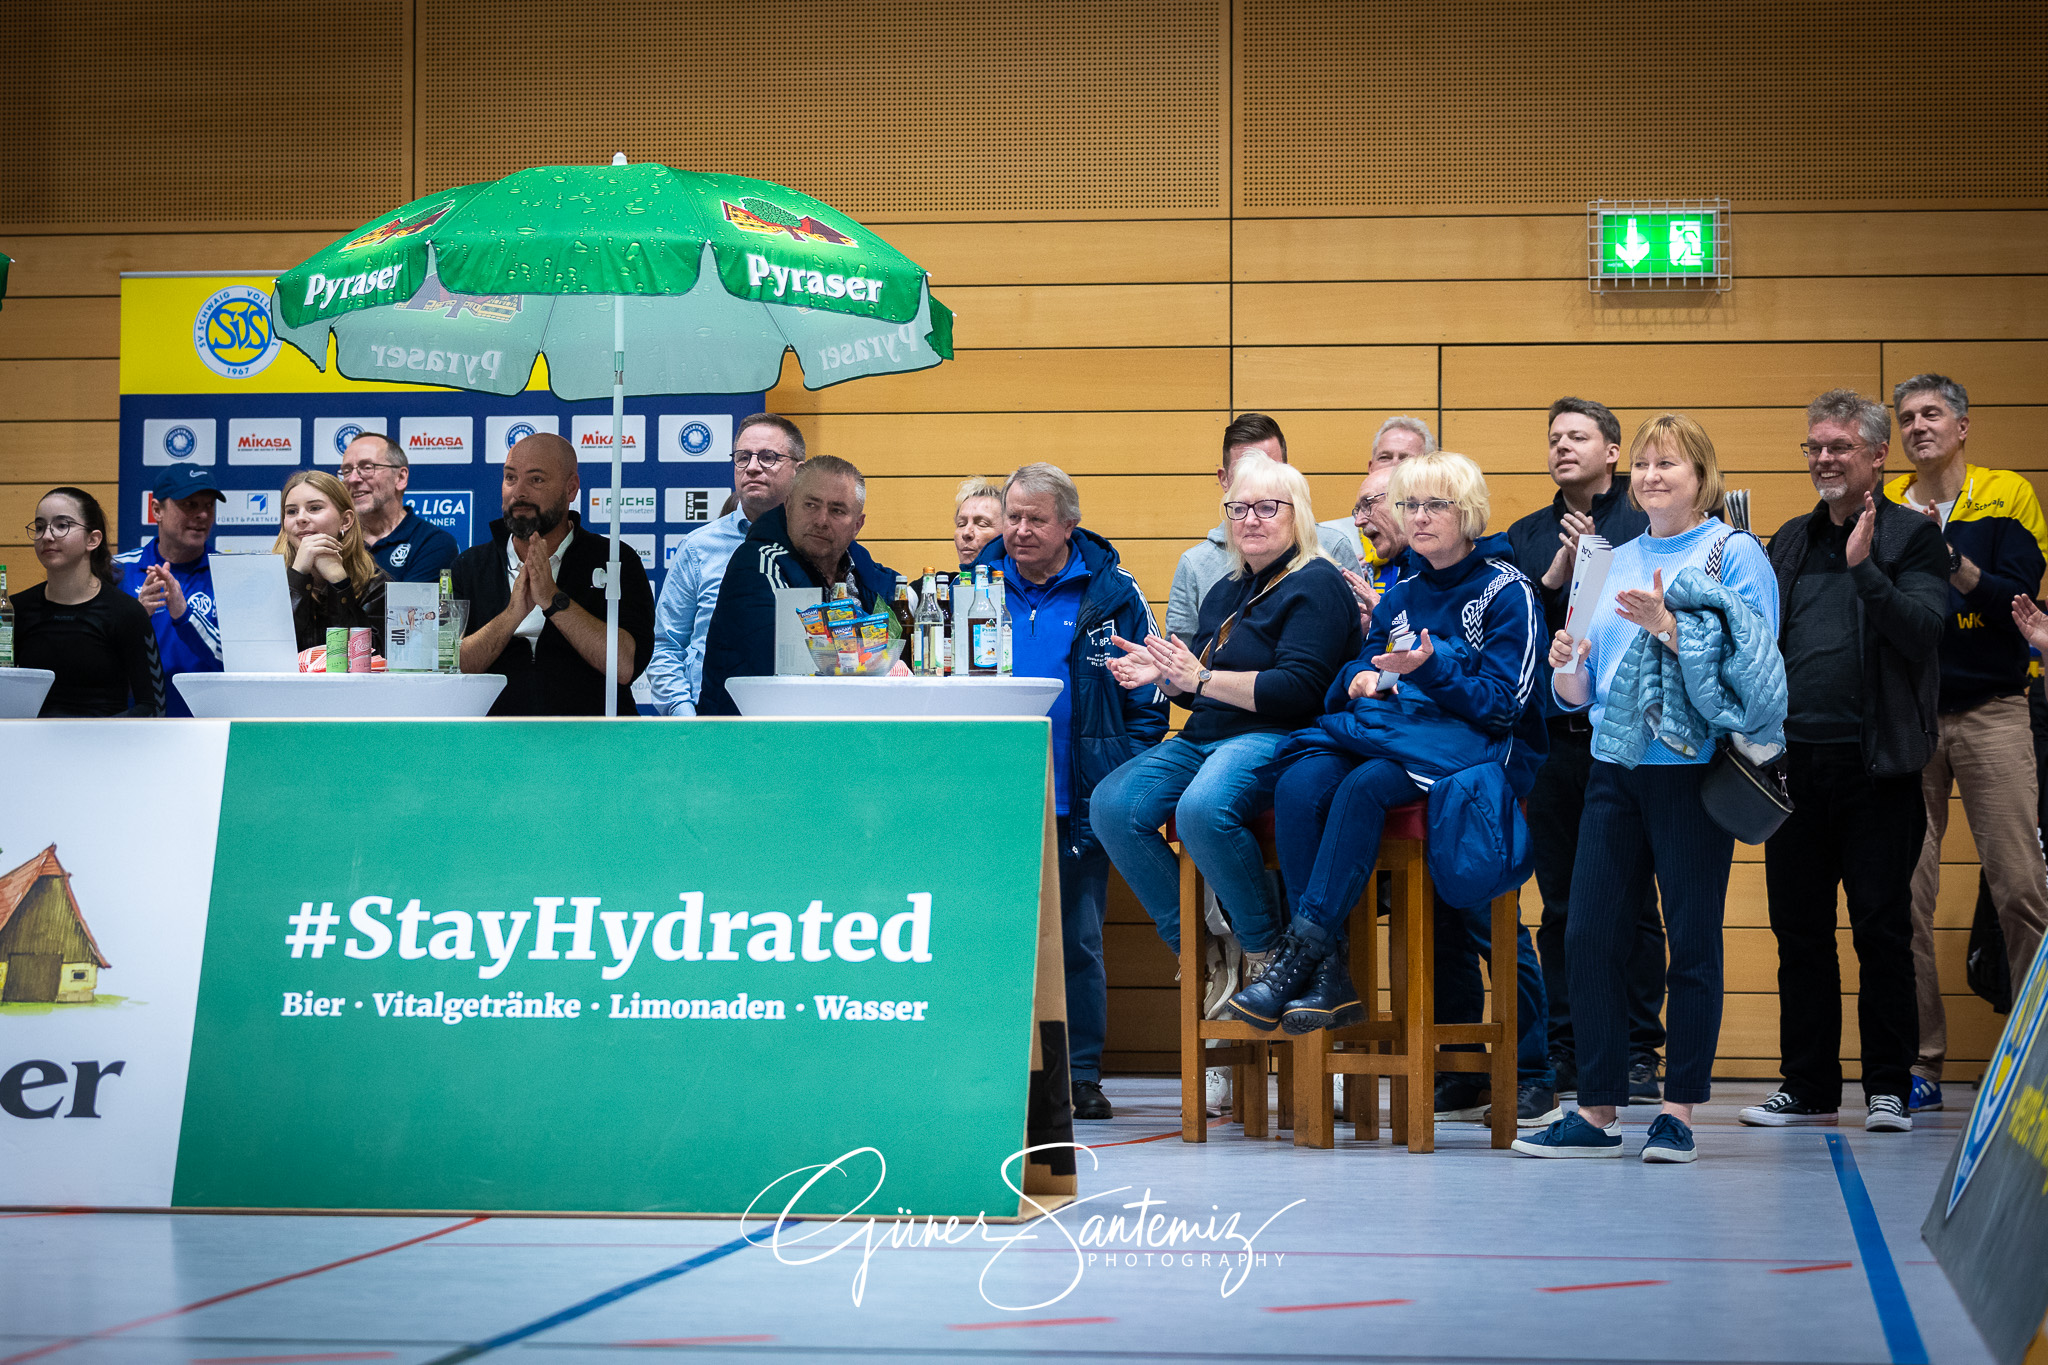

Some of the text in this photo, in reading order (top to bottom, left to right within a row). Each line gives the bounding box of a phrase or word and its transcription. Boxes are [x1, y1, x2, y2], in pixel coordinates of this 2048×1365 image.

[303, 263, 404, 311] Pyraser
[746, 252, 884, 304] Pyraser
[198, 291, 231, 331] SCHWAIG
[227, 367, 250, 376] 1967
[391, 629, 406, 646] VIP
[1957, 612, 1985, 629] WK
[284, 891, 933, 980] #StayHydrated
[281, 989, 929, 1025] Bier Vitalgetränke Limonaden Wasser
